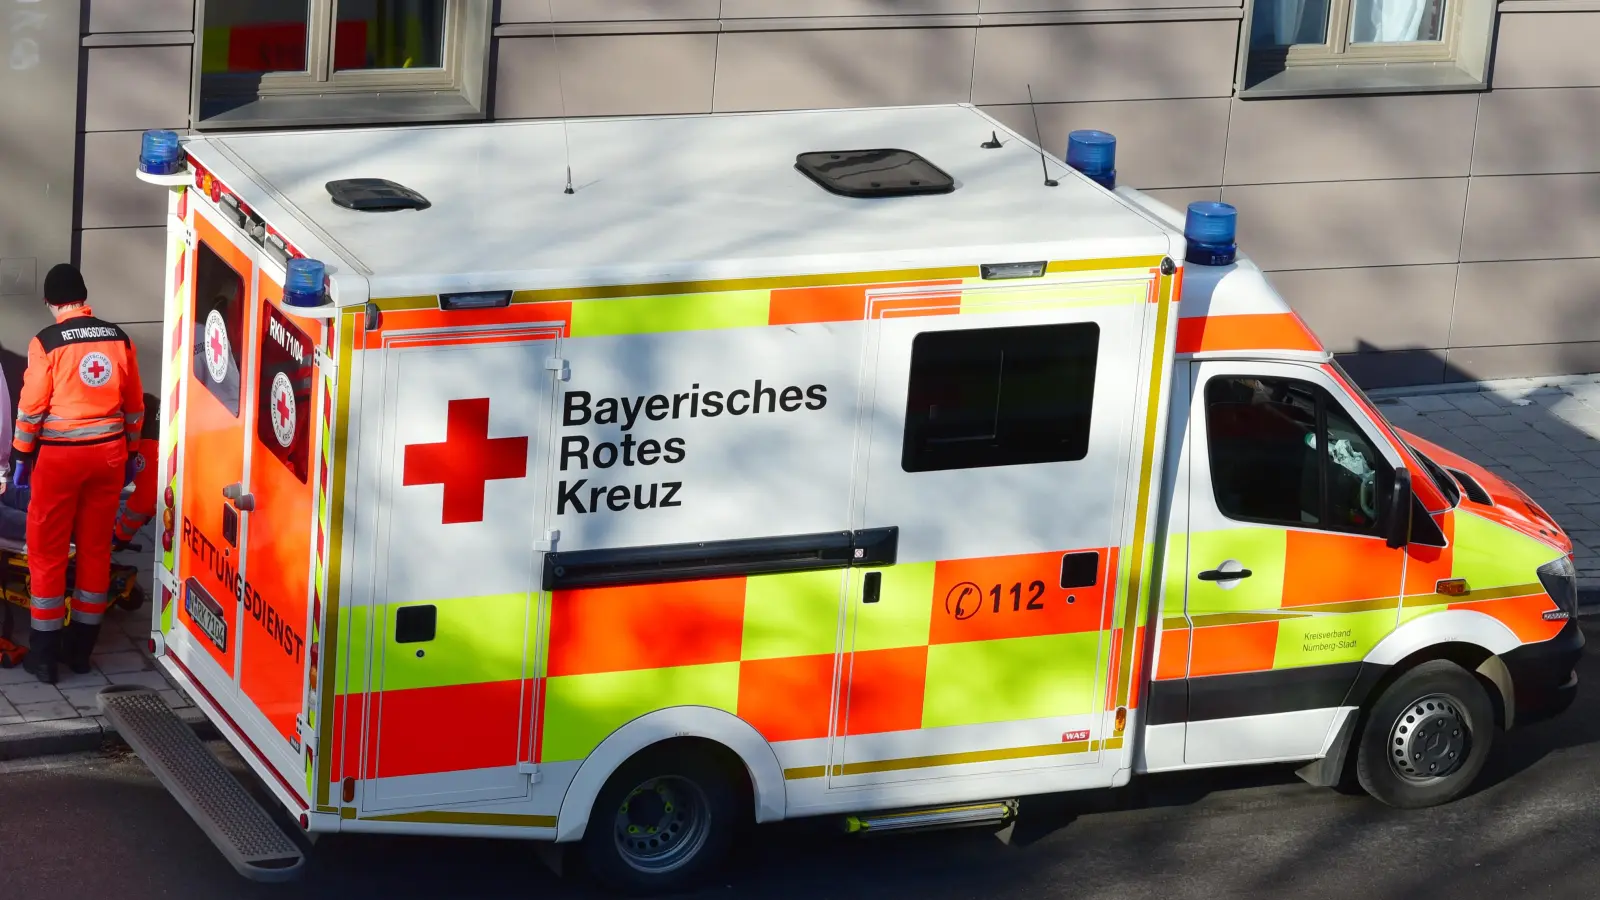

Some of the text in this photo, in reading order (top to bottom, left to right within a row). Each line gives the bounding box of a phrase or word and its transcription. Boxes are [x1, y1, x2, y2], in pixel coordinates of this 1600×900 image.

[61, 327, 117, 341] RETTUNGSDIENST
[269, 316, 304, 364] RKN 71/04
[562, 379, 828, 432] Bayerisches
[559, 433, 686, 471] Rotes
[556, 478, 683, 515] Kreuz
[183, 515, 304, 665] RETTUNGSDIENST
[989, 580, 1045, 613] 112
[1302, 640, 1357, 652] Nürnberg-Stadt
[1304, 628, 1352, 640] Kreisverband
[1065, 731, 1088, 741] WAS
